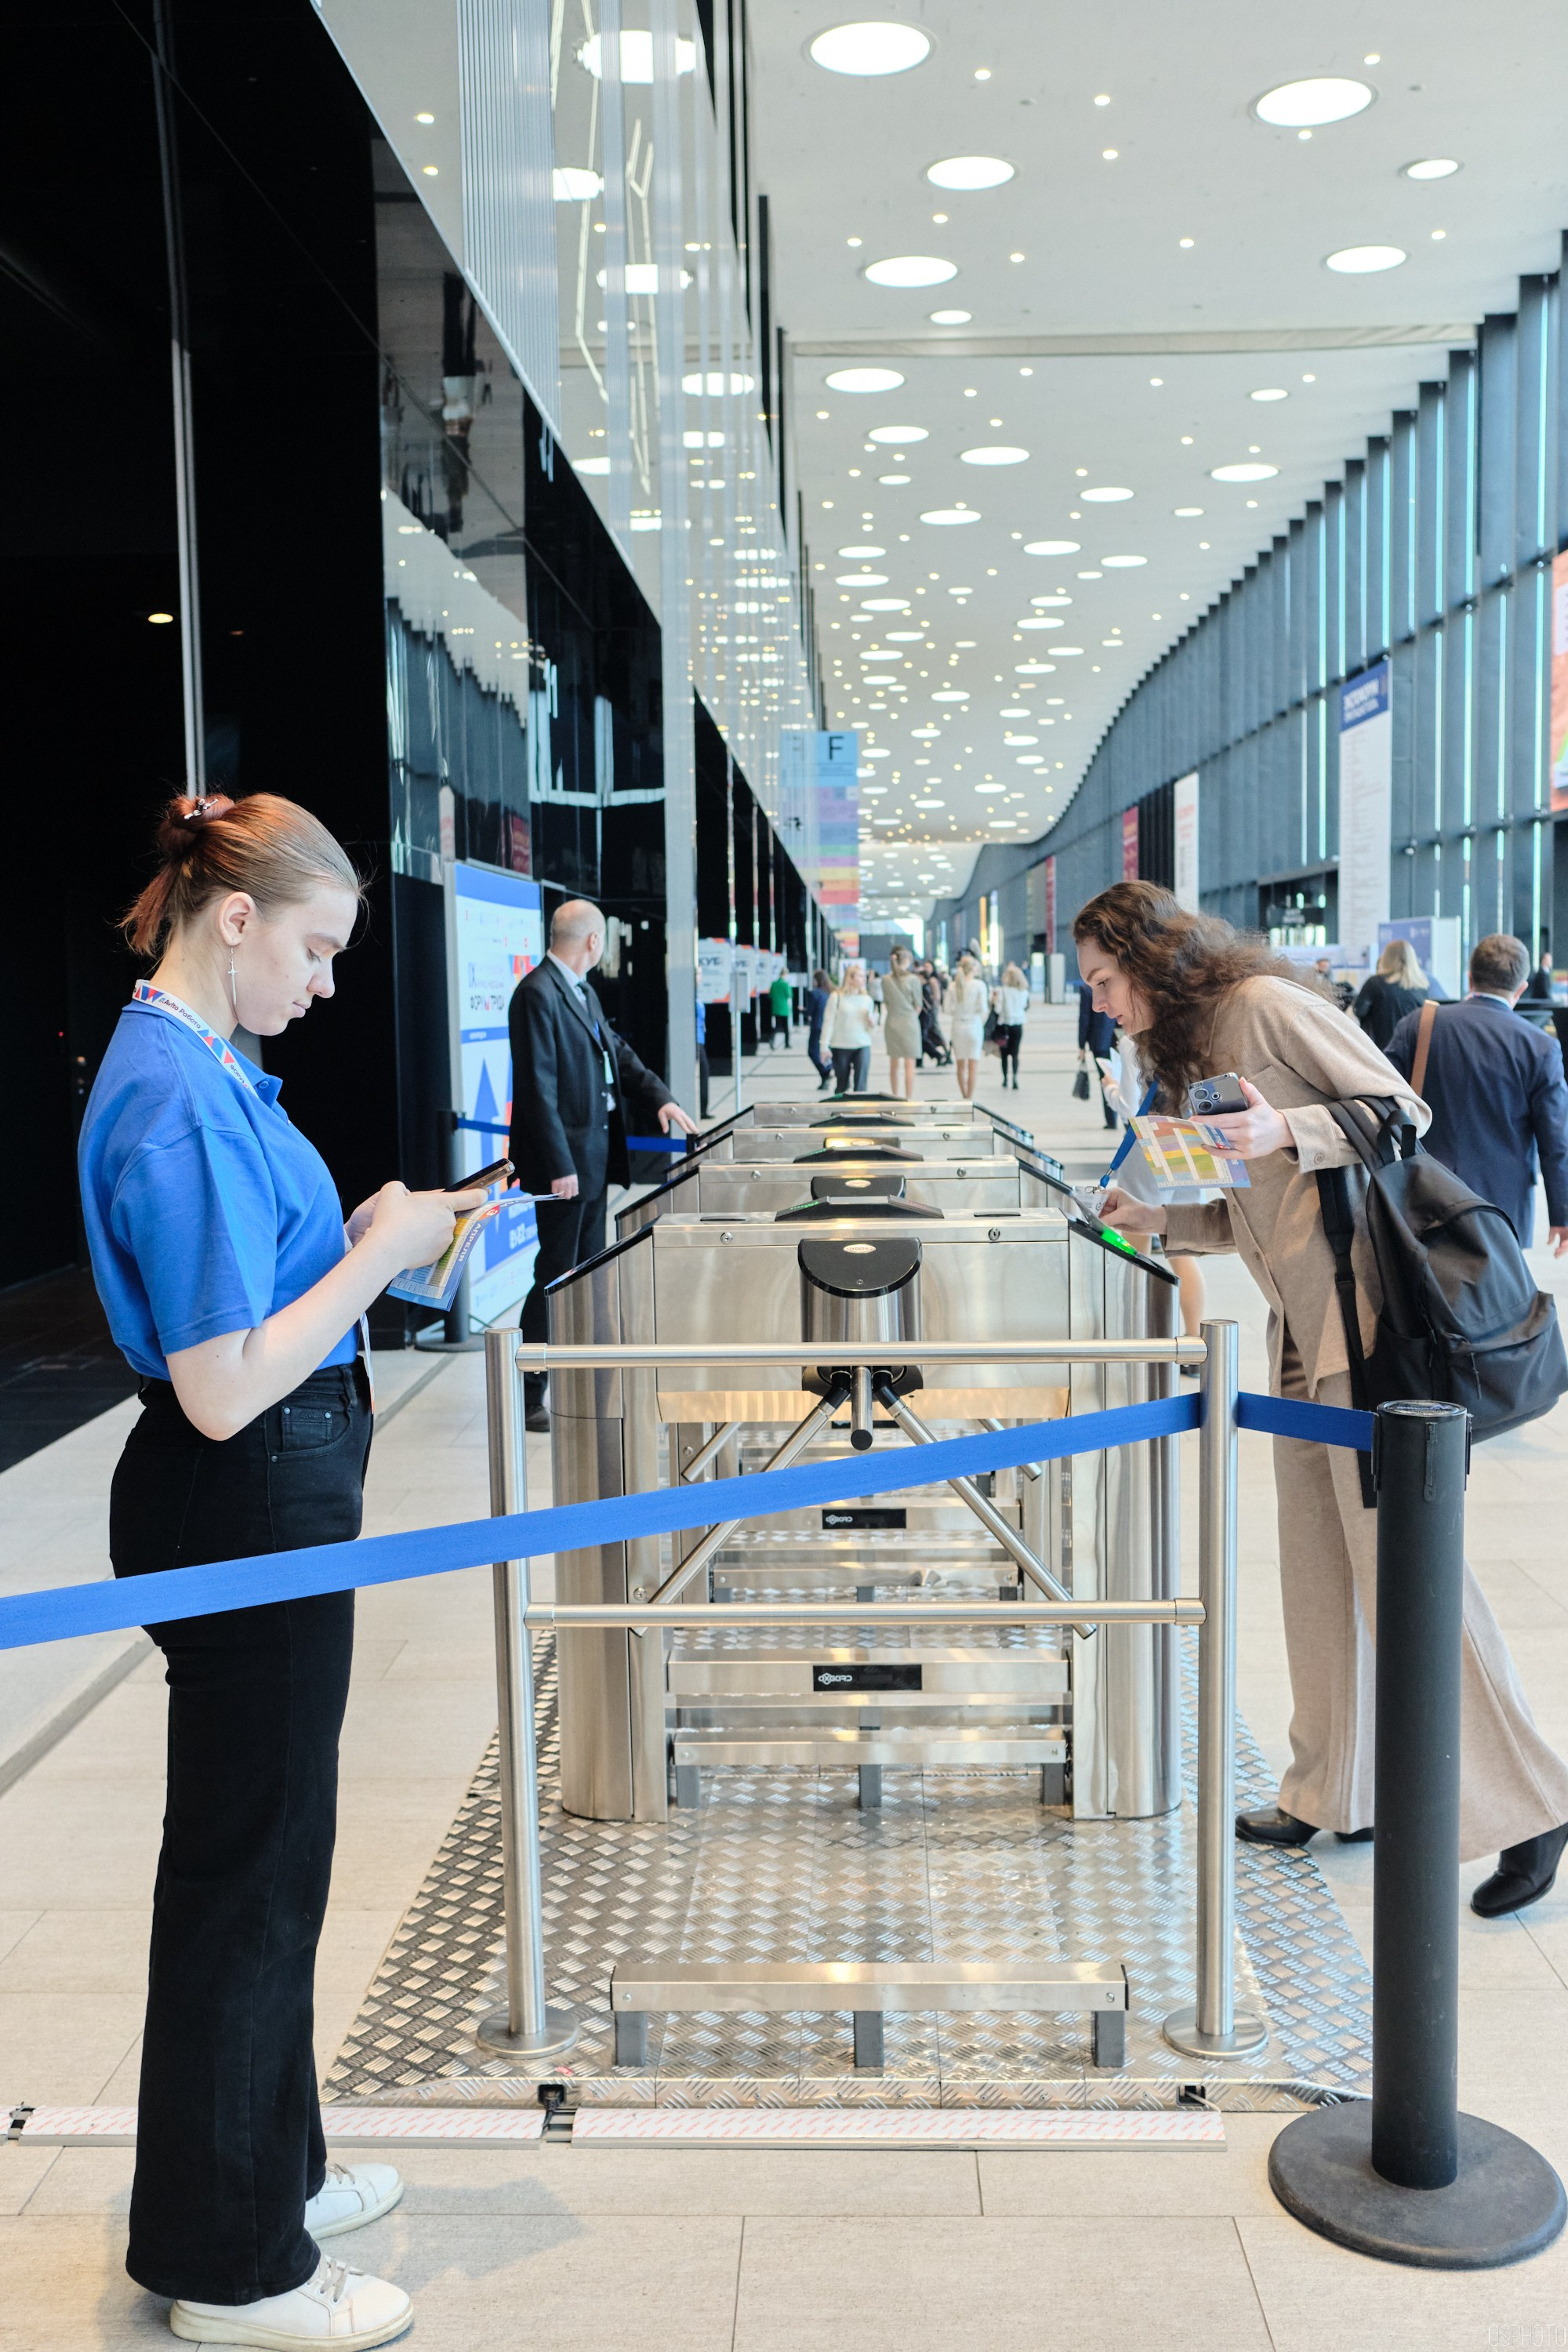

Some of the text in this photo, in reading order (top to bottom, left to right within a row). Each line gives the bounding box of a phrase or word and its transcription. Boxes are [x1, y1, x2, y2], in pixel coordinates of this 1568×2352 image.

[829, 735, 844, 760] F
[163, 999, 201, 1029] Avito Работа
[459, 1223, 481, 1261] АПРЕЛЯ
